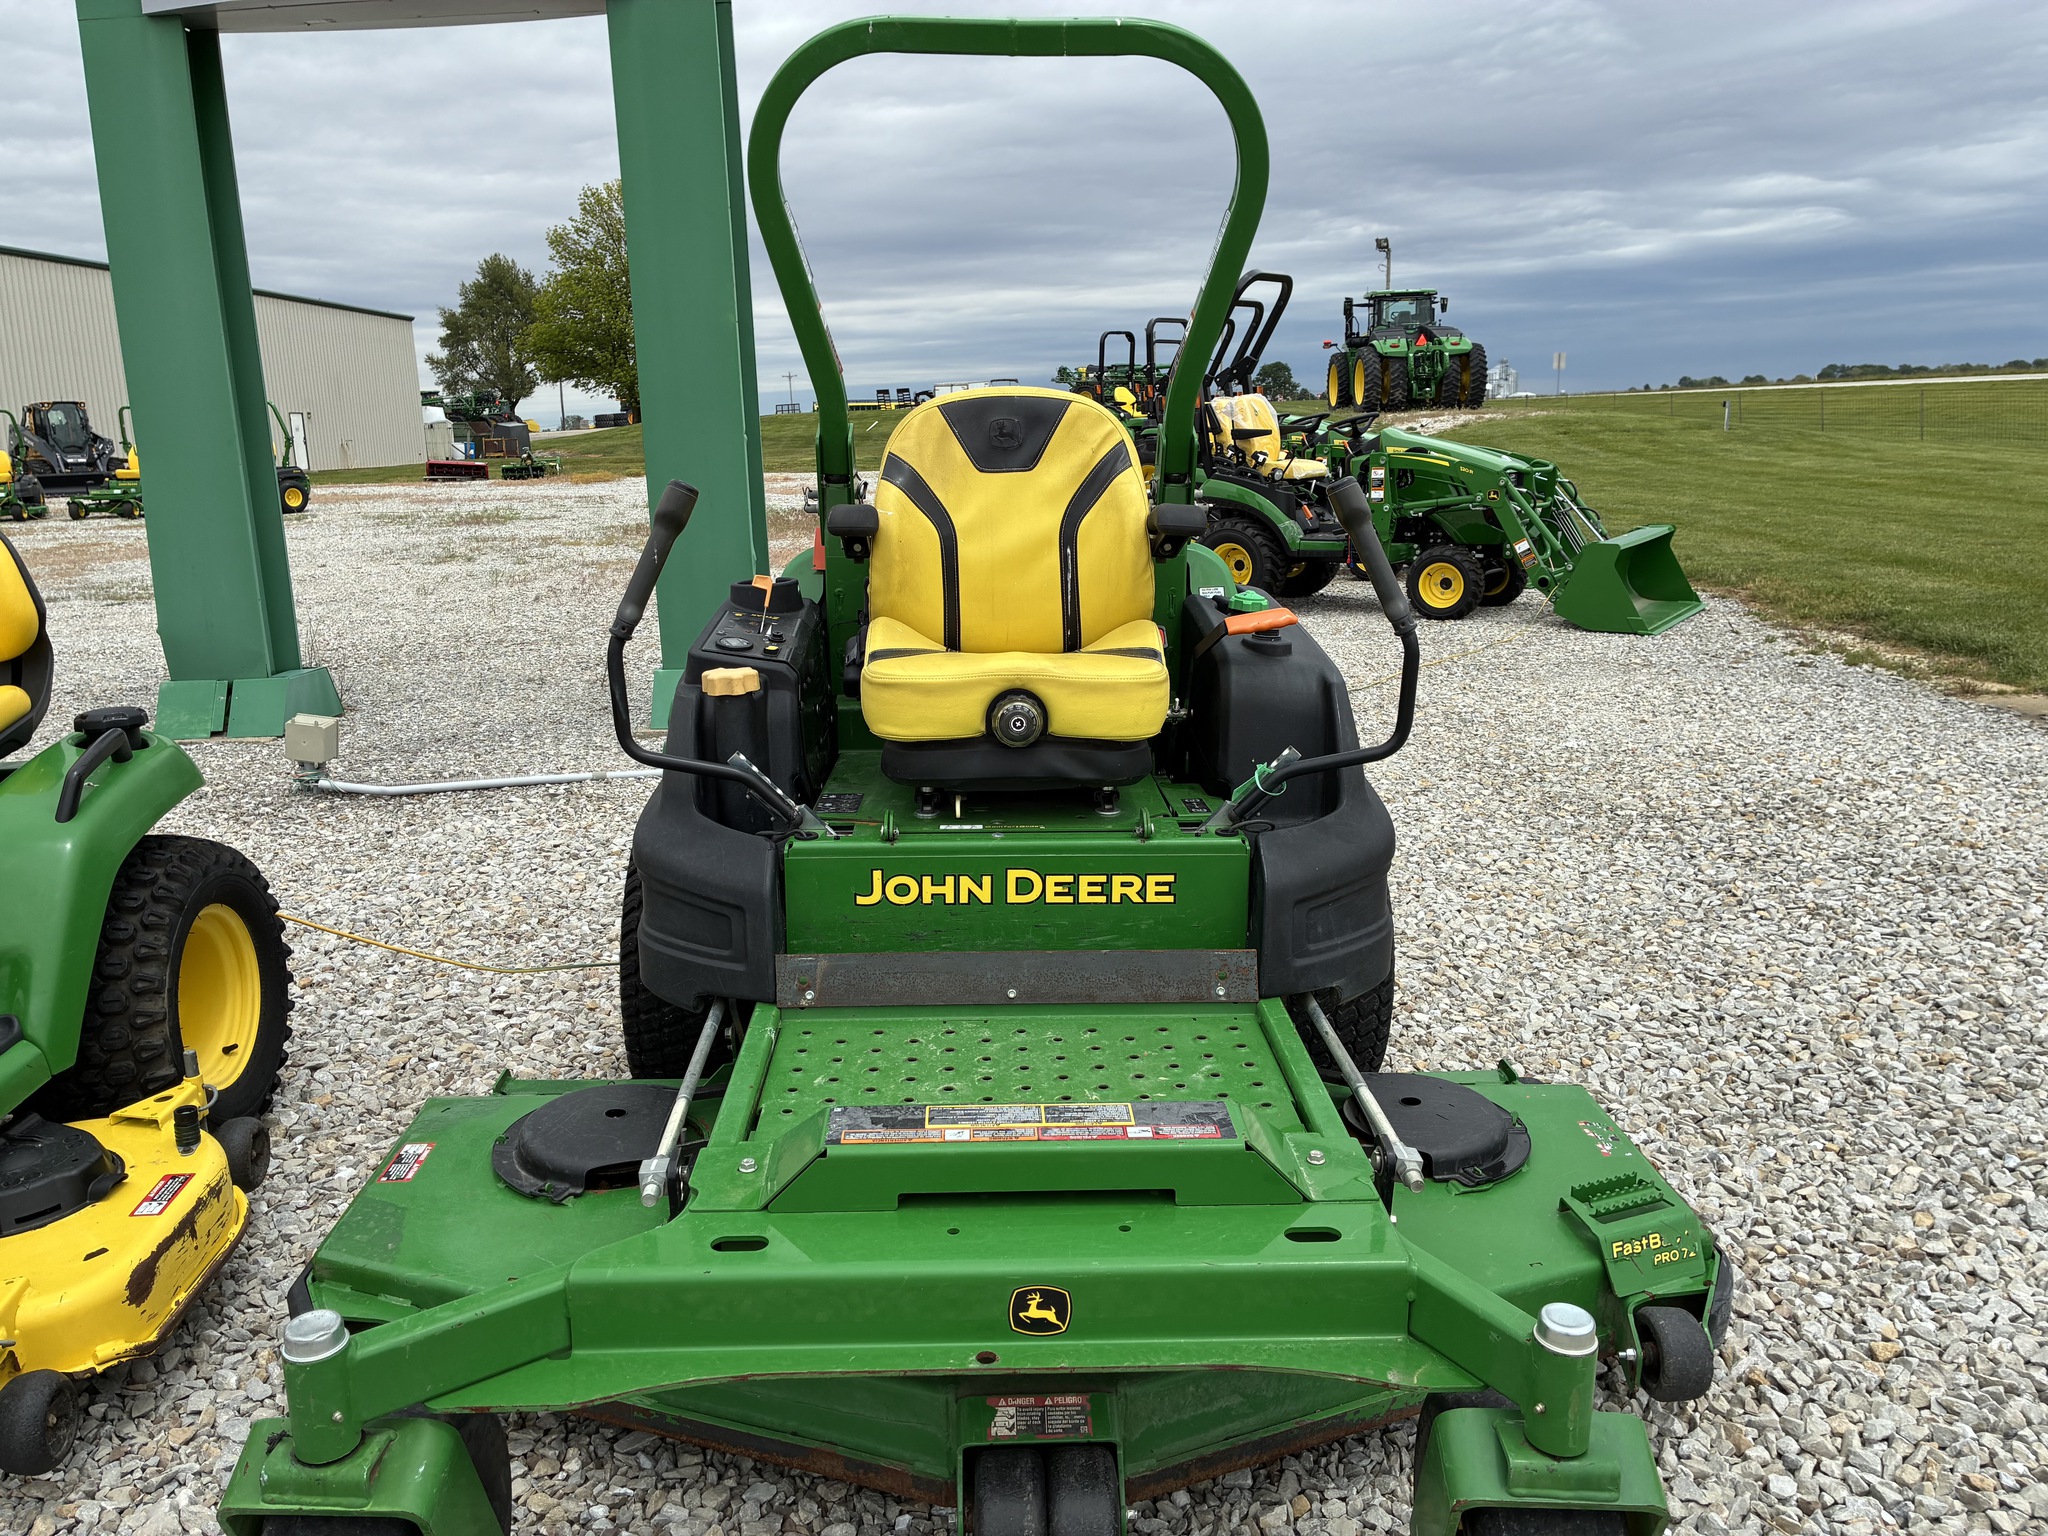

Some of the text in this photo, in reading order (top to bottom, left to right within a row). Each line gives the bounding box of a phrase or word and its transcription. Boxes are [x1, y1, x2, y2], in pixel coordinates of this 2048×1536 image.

[854, 867, 1176, 906] JOHN DEERE
[1654, 1249, 1679, 1265] PRO
[1008, 1397, 1035, 1405] DANGER
[1054, 1396, 1083, 1404] PELIGRO
